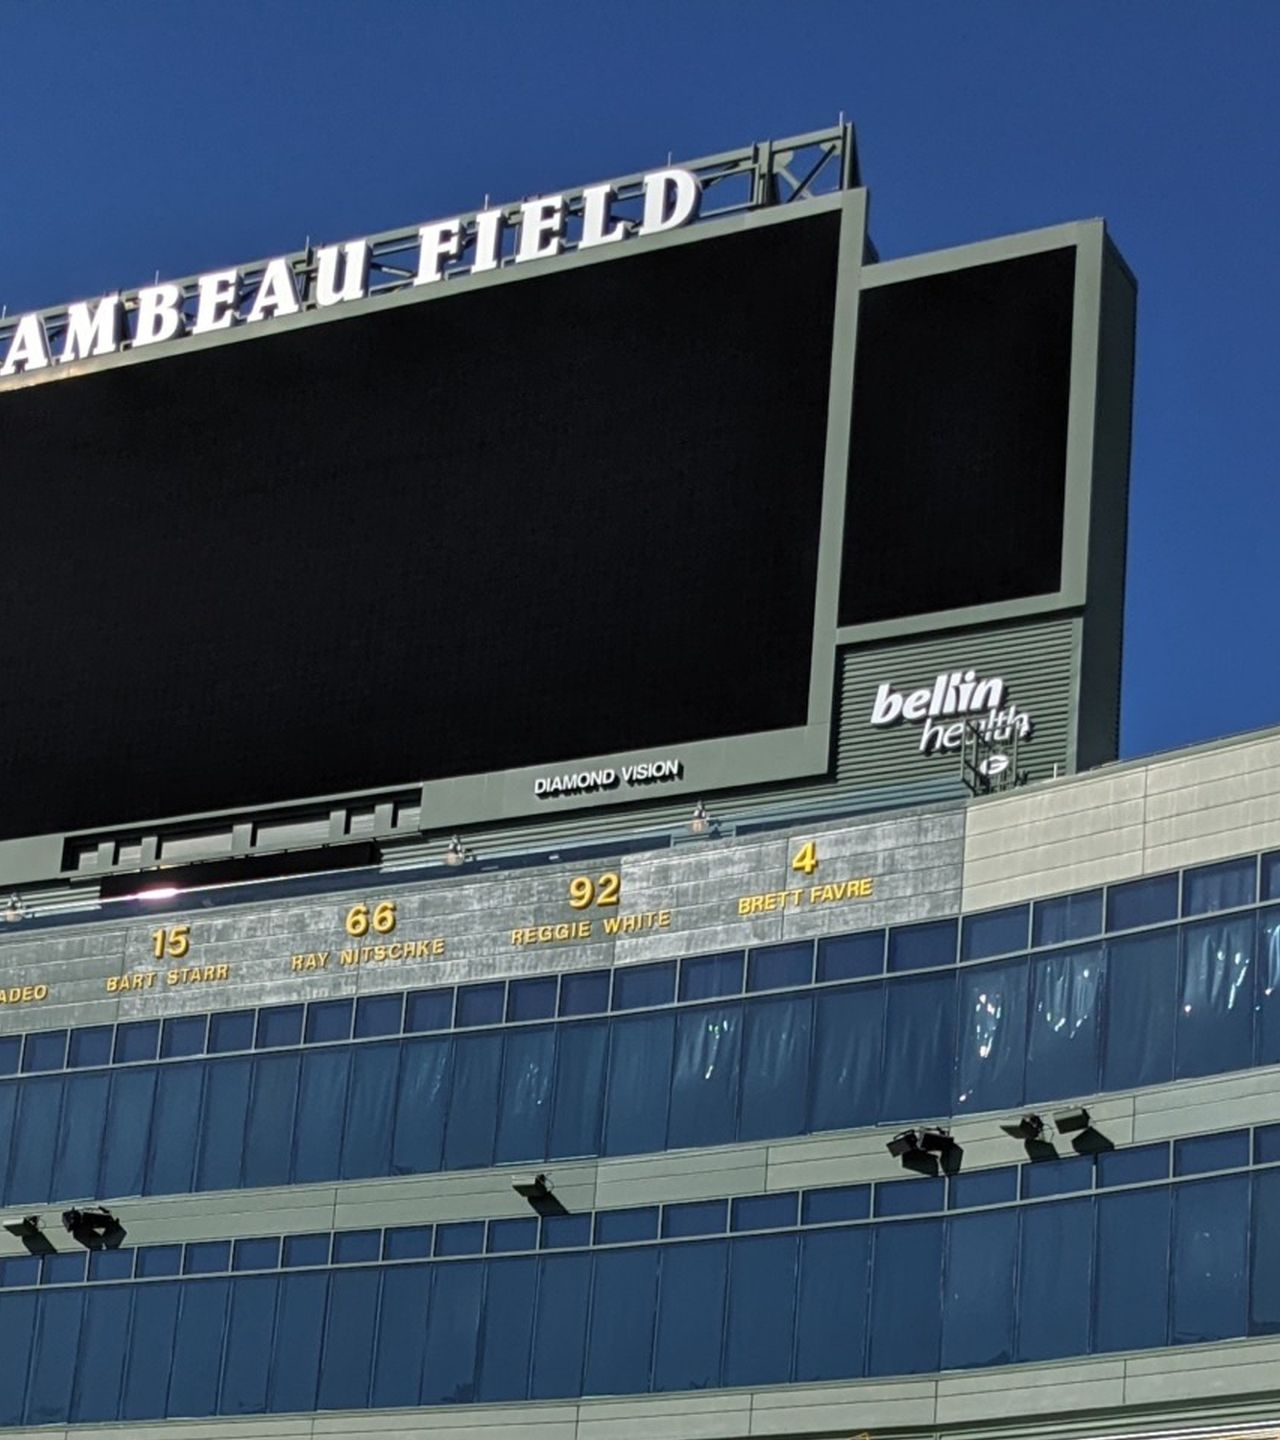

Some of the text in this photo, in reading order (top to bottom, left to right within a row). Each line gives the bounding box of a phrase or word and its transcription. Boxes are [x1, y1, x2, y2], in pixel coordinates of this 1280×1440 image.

[412, 167, 702, 286] FIELD
[871, 671, 1003, 725] bellin
[534, 759, 679, 795] DIAMOND VISION
[791, 842, 817, 874] 4
[568, 873, 620, 910] 92
[737, 877, 873, 915] BRETT FAVRE
[344, 901, 396, 936] 66
[510, 909, 671, 945] REGGIE WHITE
[150, 926, 190, 958] 15
[290, 938, 445, 970] RAY NITSCHKE
[106, 963, 230, 992] BART STARR
